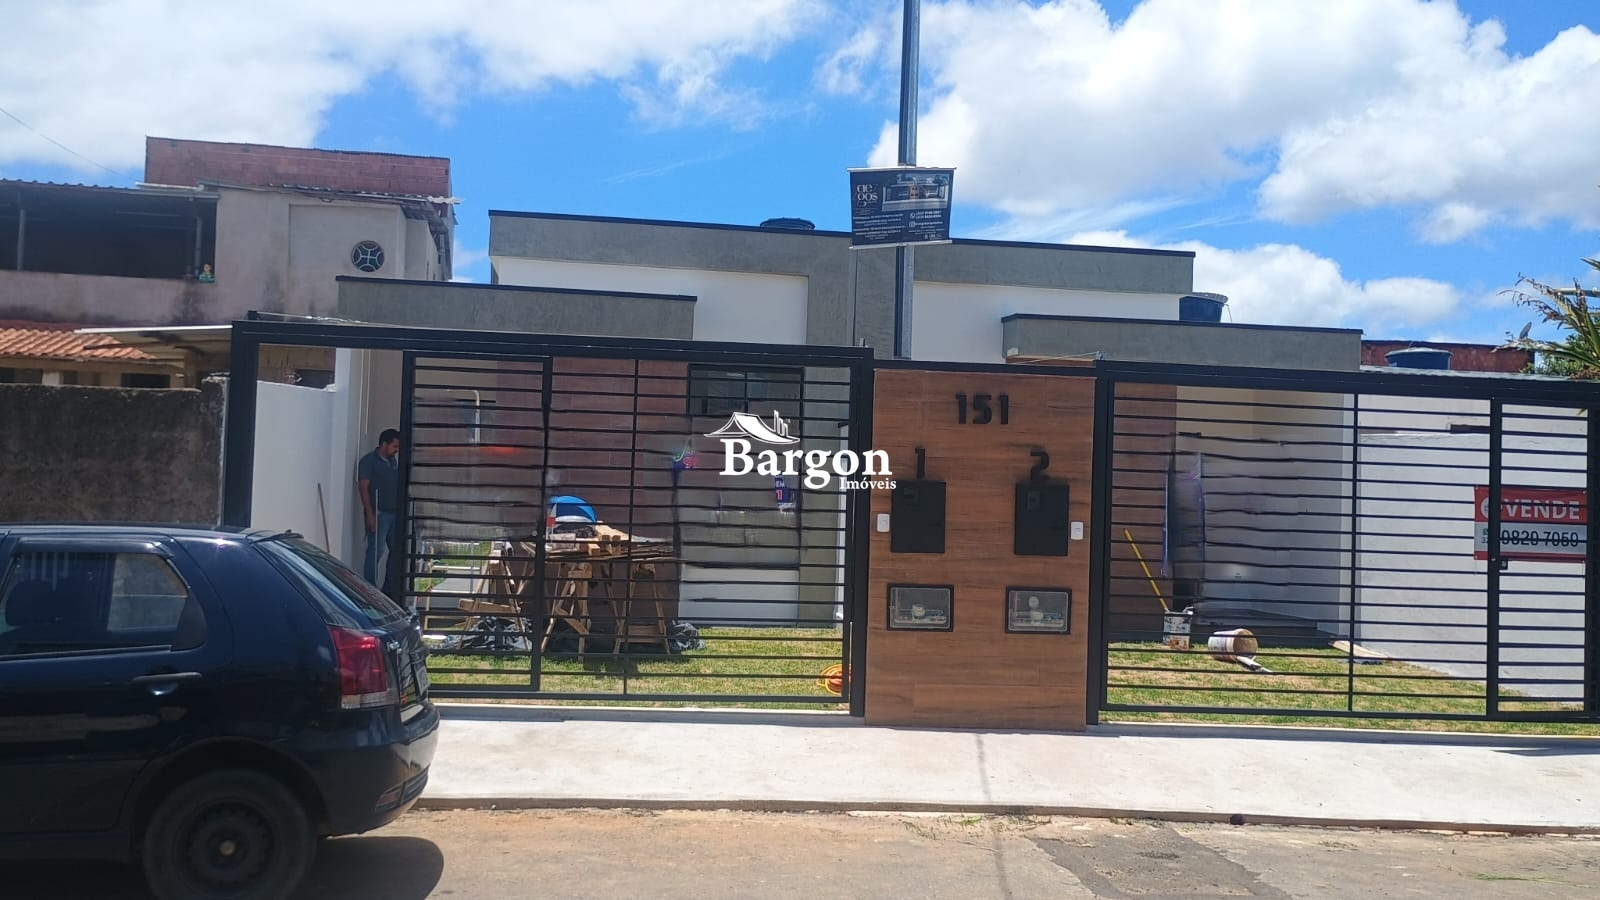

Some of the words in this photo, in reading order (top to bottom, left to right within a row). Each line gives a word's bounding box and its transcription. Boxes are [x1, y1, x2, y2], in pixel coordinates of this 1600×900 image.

[955, 394, 1009, 425] 151
[914, 448, 926, 479] 1
[1029, 449, 1050, 480] 2
[1503, 498, 1580, 520] VENDE
